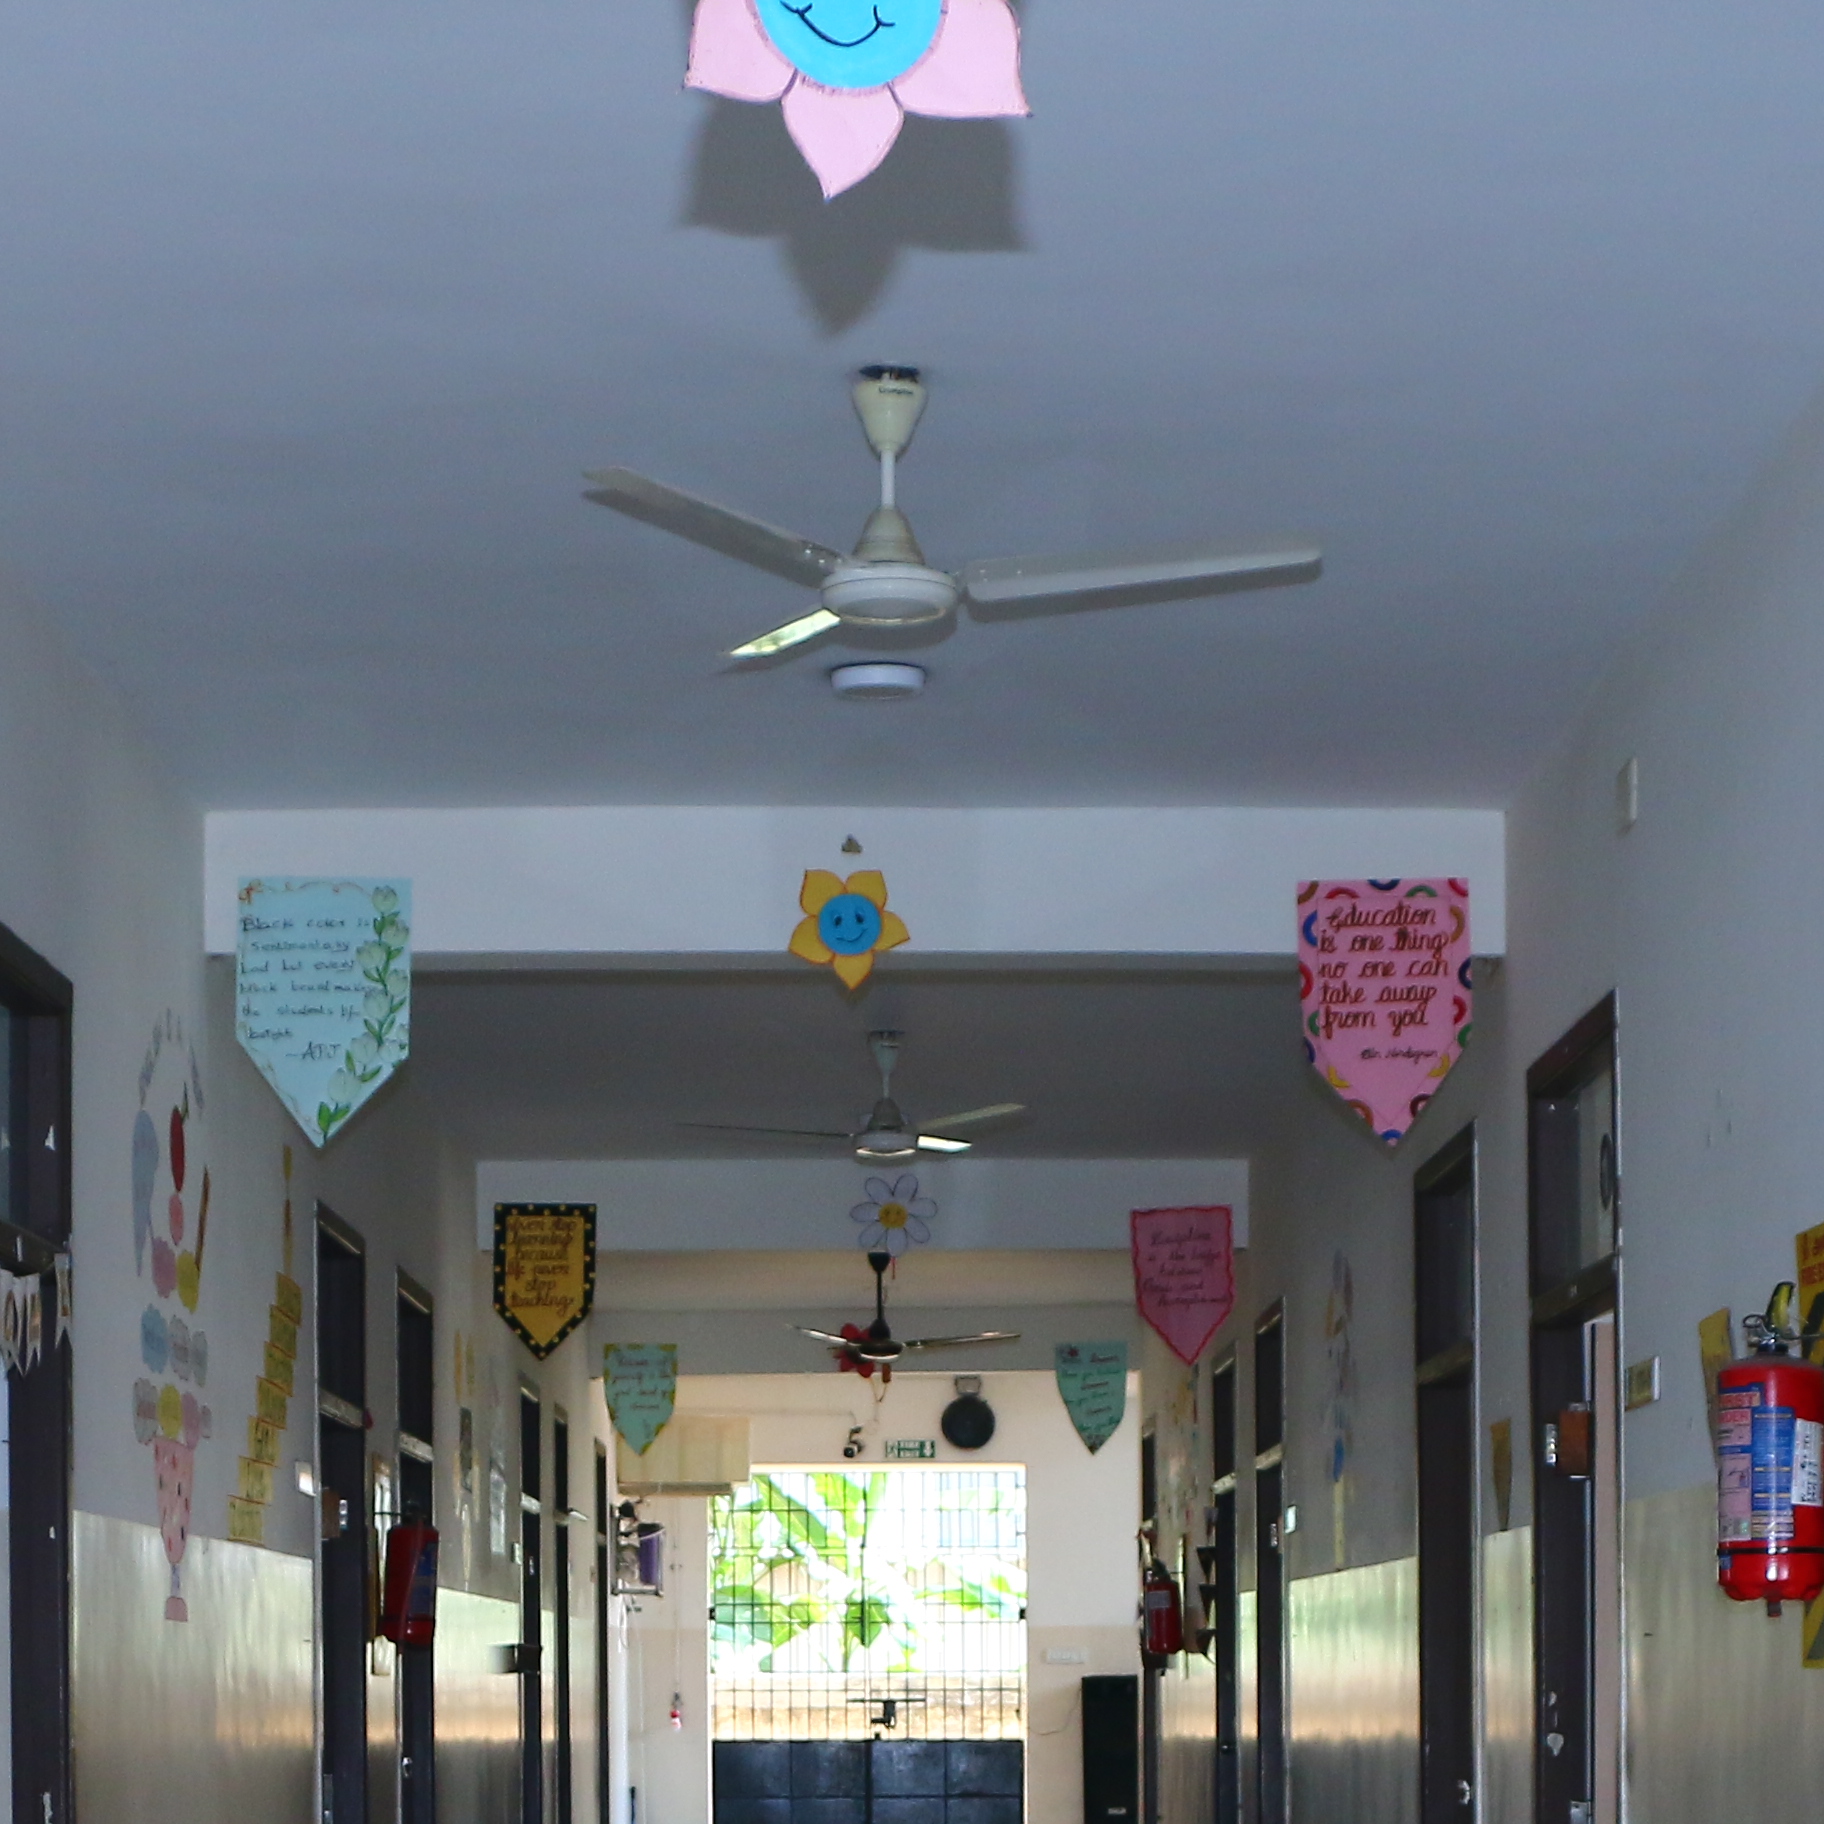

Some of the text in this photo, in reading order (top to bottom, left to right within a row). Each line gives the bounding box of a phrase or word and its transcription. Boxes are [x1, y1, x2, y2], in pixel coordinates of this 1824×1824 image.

[1325, 900, 1437, 933] Education
[1348, 933, 1384, 953] one
[1389, 926, 1449, 959] thing
[1318, 958, 1449, 979] no one can
[1319, 979, 1437, 1012] take away
[1322, 1004, 1429, 1040] from you
